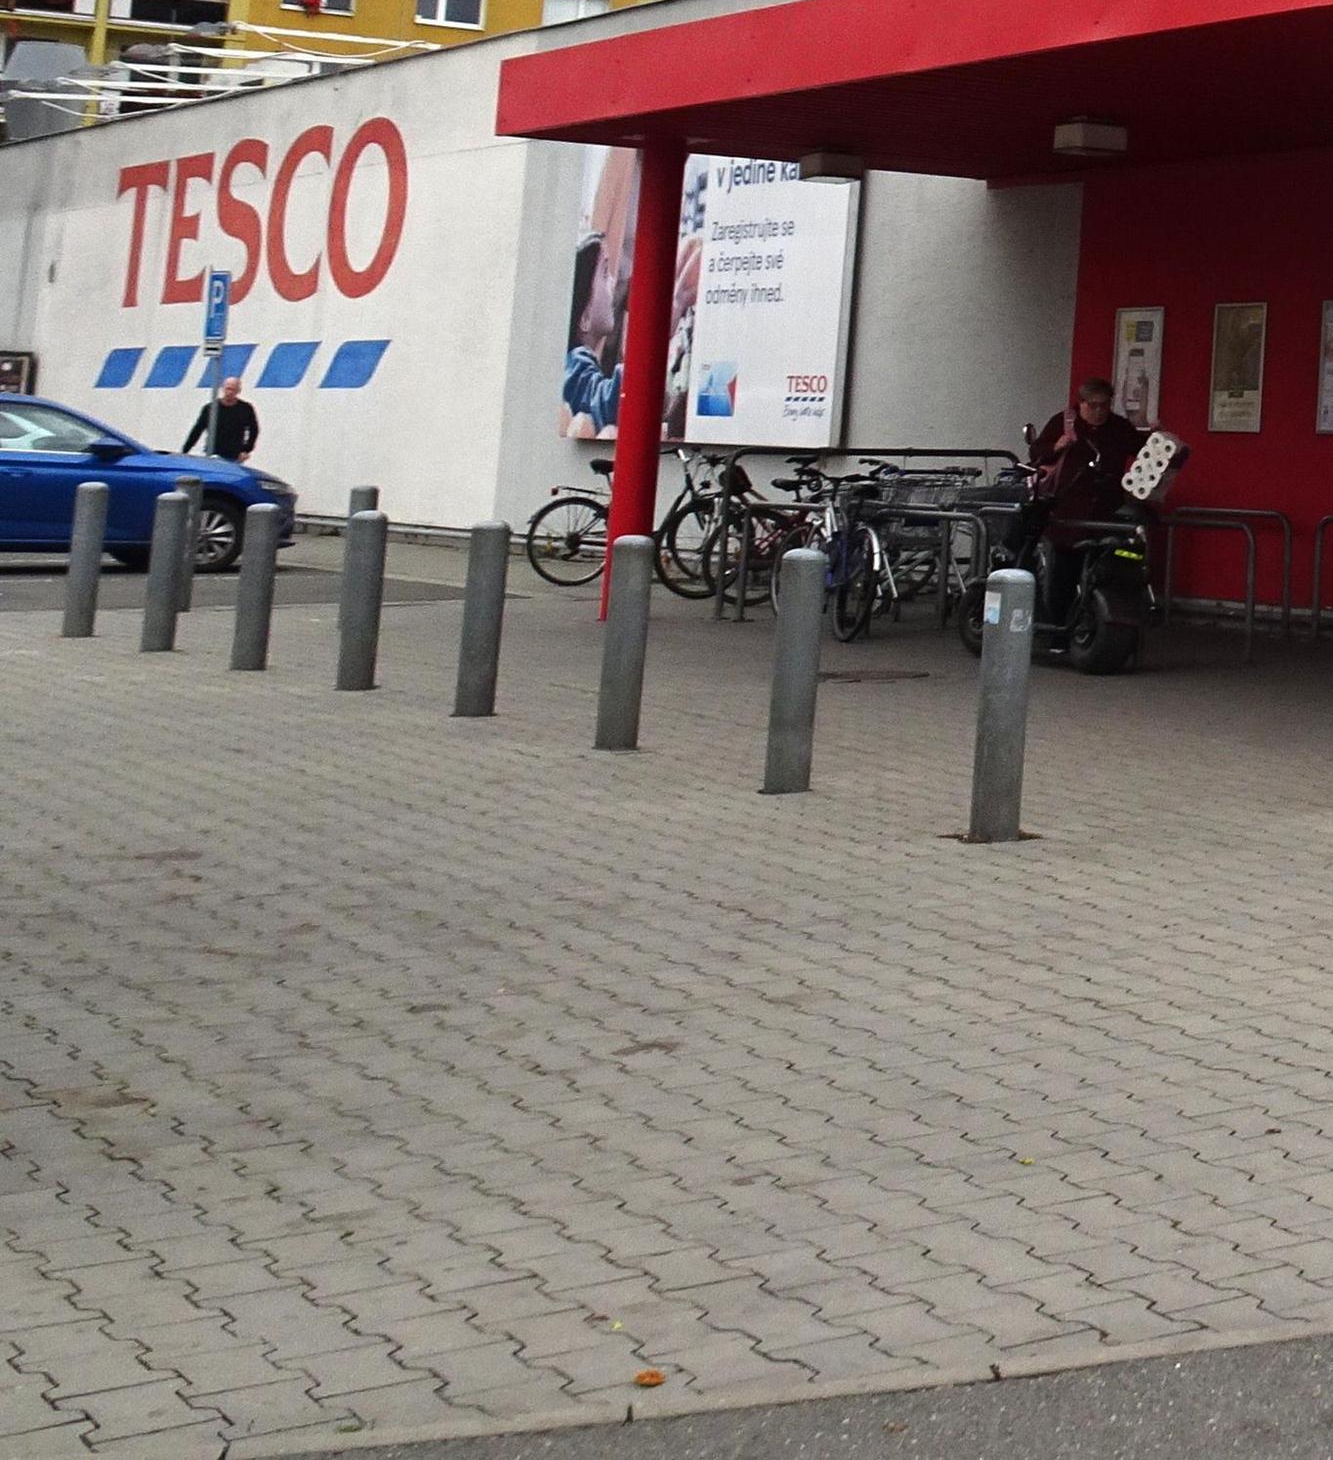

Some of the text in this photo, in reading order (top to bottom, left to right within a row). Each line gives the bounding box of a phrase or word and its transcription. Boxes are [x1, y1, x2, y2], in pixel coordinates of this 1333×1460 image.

[716, 166, 726, 188] v
[116, 116, 408, 308] TESCO
[711, 218, 795, 245] Zaregistrujte se
[708, 248, 784, 276] a čerpejte své
[749, 282, 784, 304] ihned.
[786, 375, 828, 393] TESCO
